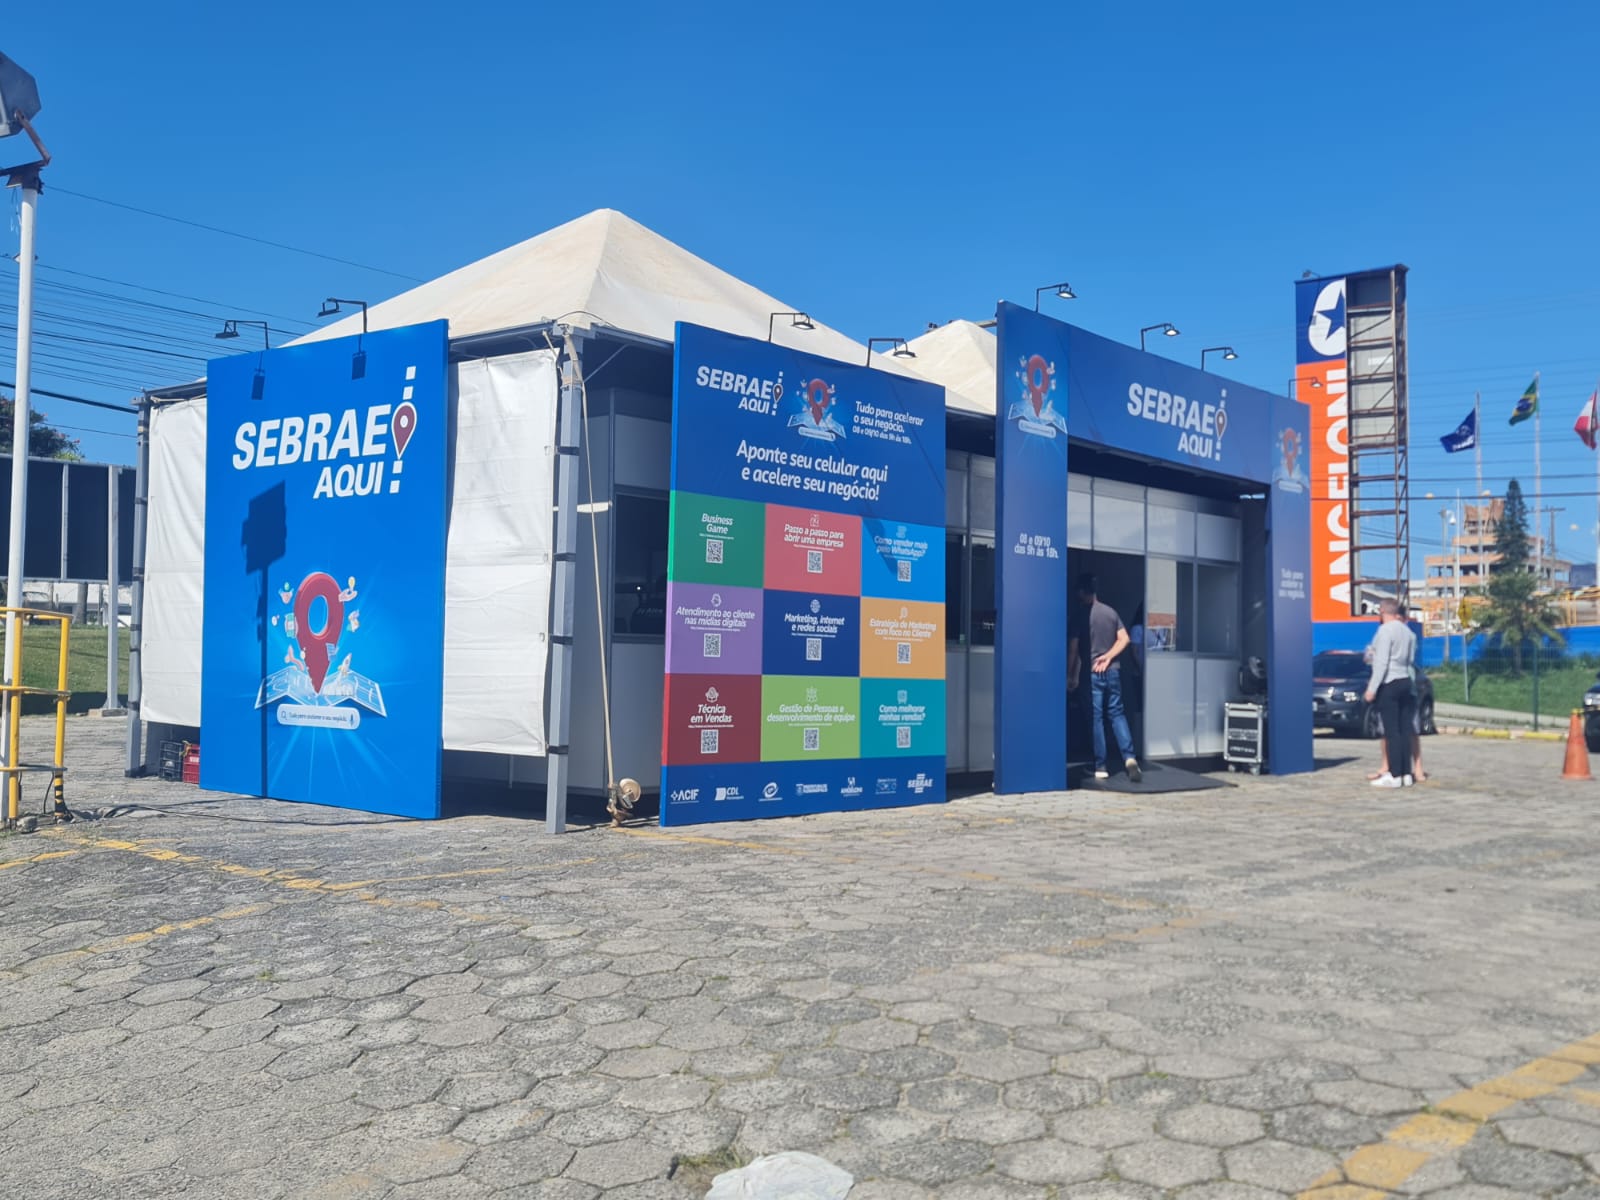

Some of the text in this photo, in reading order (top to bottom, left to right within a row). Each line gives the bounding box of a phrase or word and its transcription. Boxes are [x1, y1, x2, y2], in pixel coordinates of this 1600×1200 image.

[696, 365, 774, 400] SEBRAE
[738, 397, 770, 414] AQUI
[1127, 383, 1216, 435] SEBRAE
[853, 415, 860, 423] o
[860, 416, 874, 426] seu
[856, 401, 924, 426] Tudo para acelerar
[232, 404, 392, 470] SEBRAE
[1177, 431, 1213, 459] AQUI
[736, 439, 888, 485] Aponte seu celular aqui
[313, 461, 385, 499] AQUI
[741, 466, 880, 501] e acelere seu negócio!
[701, 513, 734, 526] Business
[706, 523, 729, 534] Game
[784, 524, 803, 534] Passo
[809, 529, 829, 538] passo
[829, 531, 845, 540] para
[784, 533, 800, 543] abrir
[801, 536, 816, 545] uma
[816, 538, 845, 548] empresa
[676, 606, 722, 617] Atendimento
[722, 610, 732, 618] ao
[733, 608, 756, 619] cliente
[784, 613, 845, 625] Marketing, internet
[685, 616, 697, 625] nas
[721, 618, 746, 628] digitais
[797, 623, 816, 632] redes
[816, 625, 838, 633] sociais
[698, 704, 726, 714] Técnica
[690, 714, 733, 723] em Vendas
[677, 789, 700, 801] ACIF
[726, 786, 739, 795] CDL
